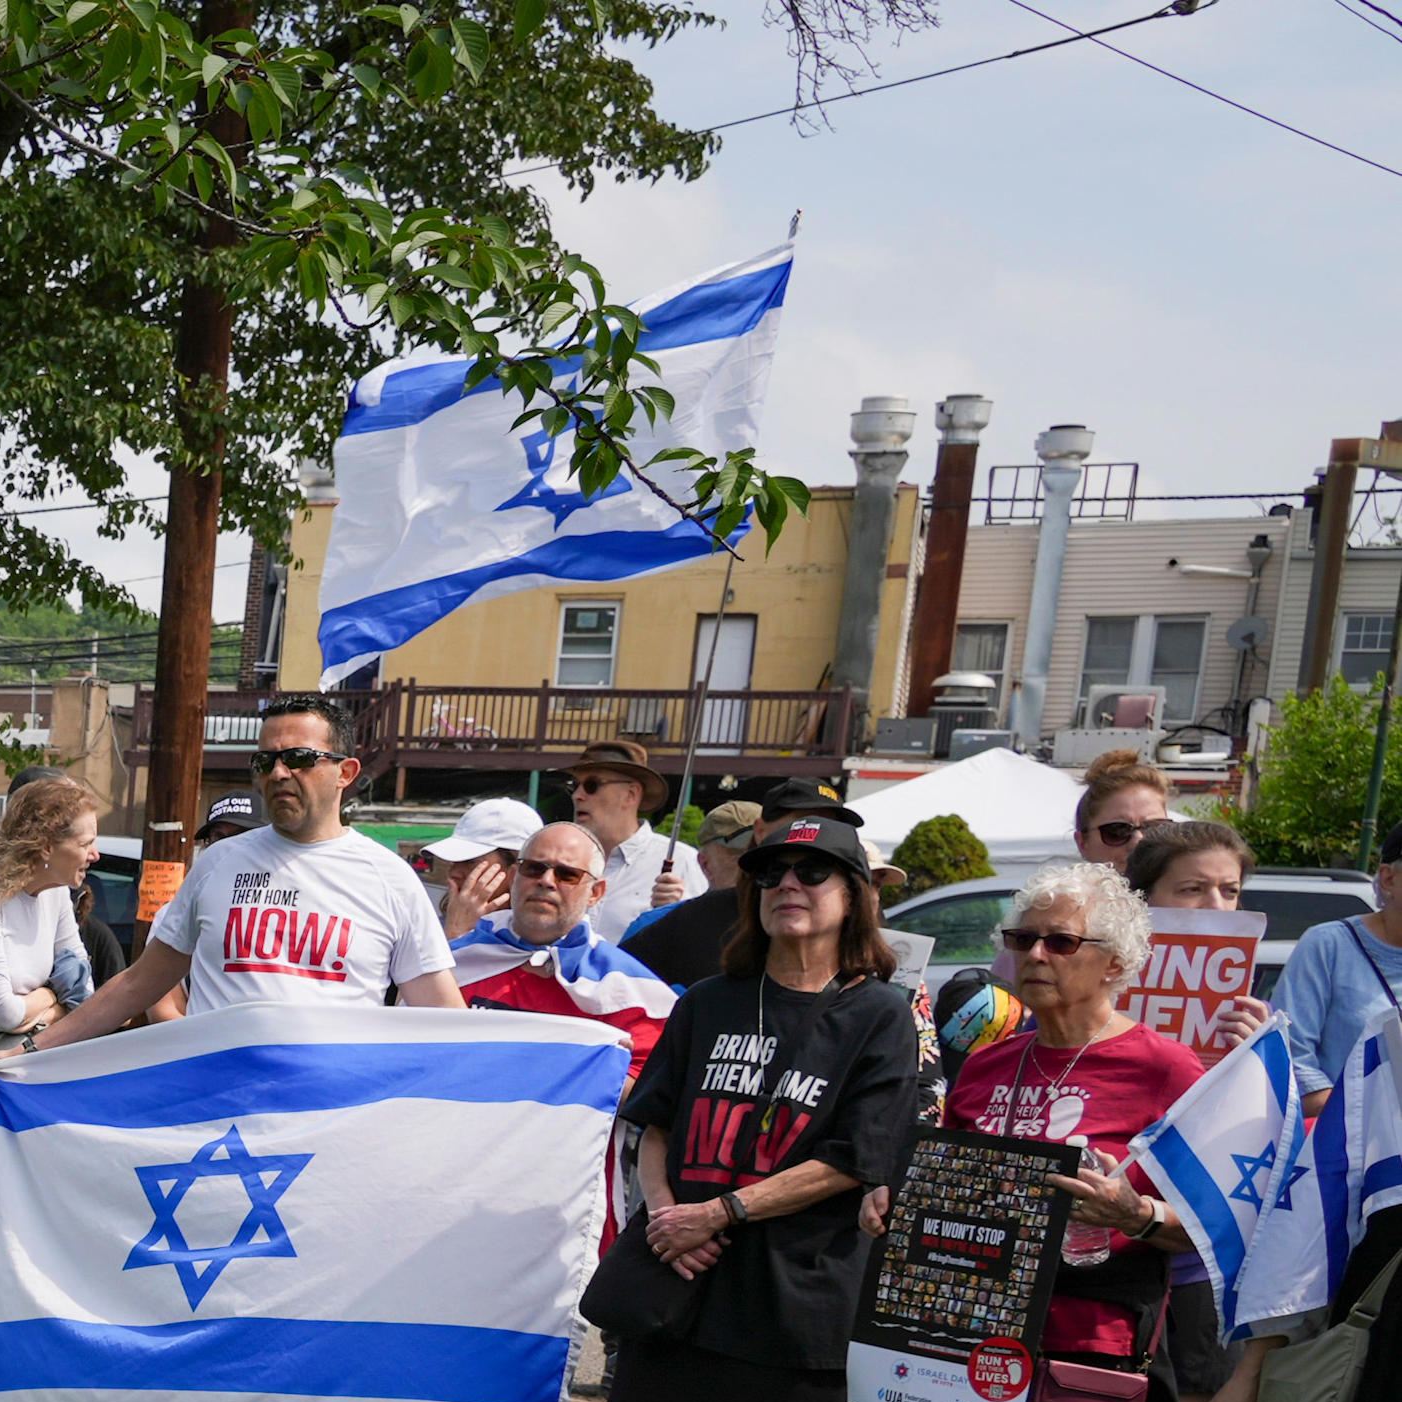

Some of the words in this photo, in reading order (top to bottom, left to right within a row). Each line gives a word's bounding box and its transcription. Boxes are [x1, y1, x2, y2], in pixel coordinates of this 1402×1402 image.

[231, 798, 252, 806] OUR
[234, 872, 271, 888] BRING
[231, 889, 262, 905] THEM
[264, 890, 299, 907] HOME
[223, 907, 352, 971] NOW!
[1128, 944, 1247, 994] ING
[1110, 993, 1235, 1049] HEM
[709, 1033, 778, 1065] BRING
[701, 1063, 763, 1096] THEM
[772, 1069, 829, 1108] OME
[984, 1104, 1006, 1116] FOR
[1015, 1105, 1042, 1118] HEIR
[922, 1218, 941, 1235] WE
[941, 1220, 976, 1241] WON'T
[976, 1226, 1006, 1246] STOP
[977, 1354, 1002, 1367] RUN
[917, 1368, 949, 1381] ISRAEL
[951, 1374, 968, 1385] DAY
[974, 1370, 1009, 1384] LIVES
